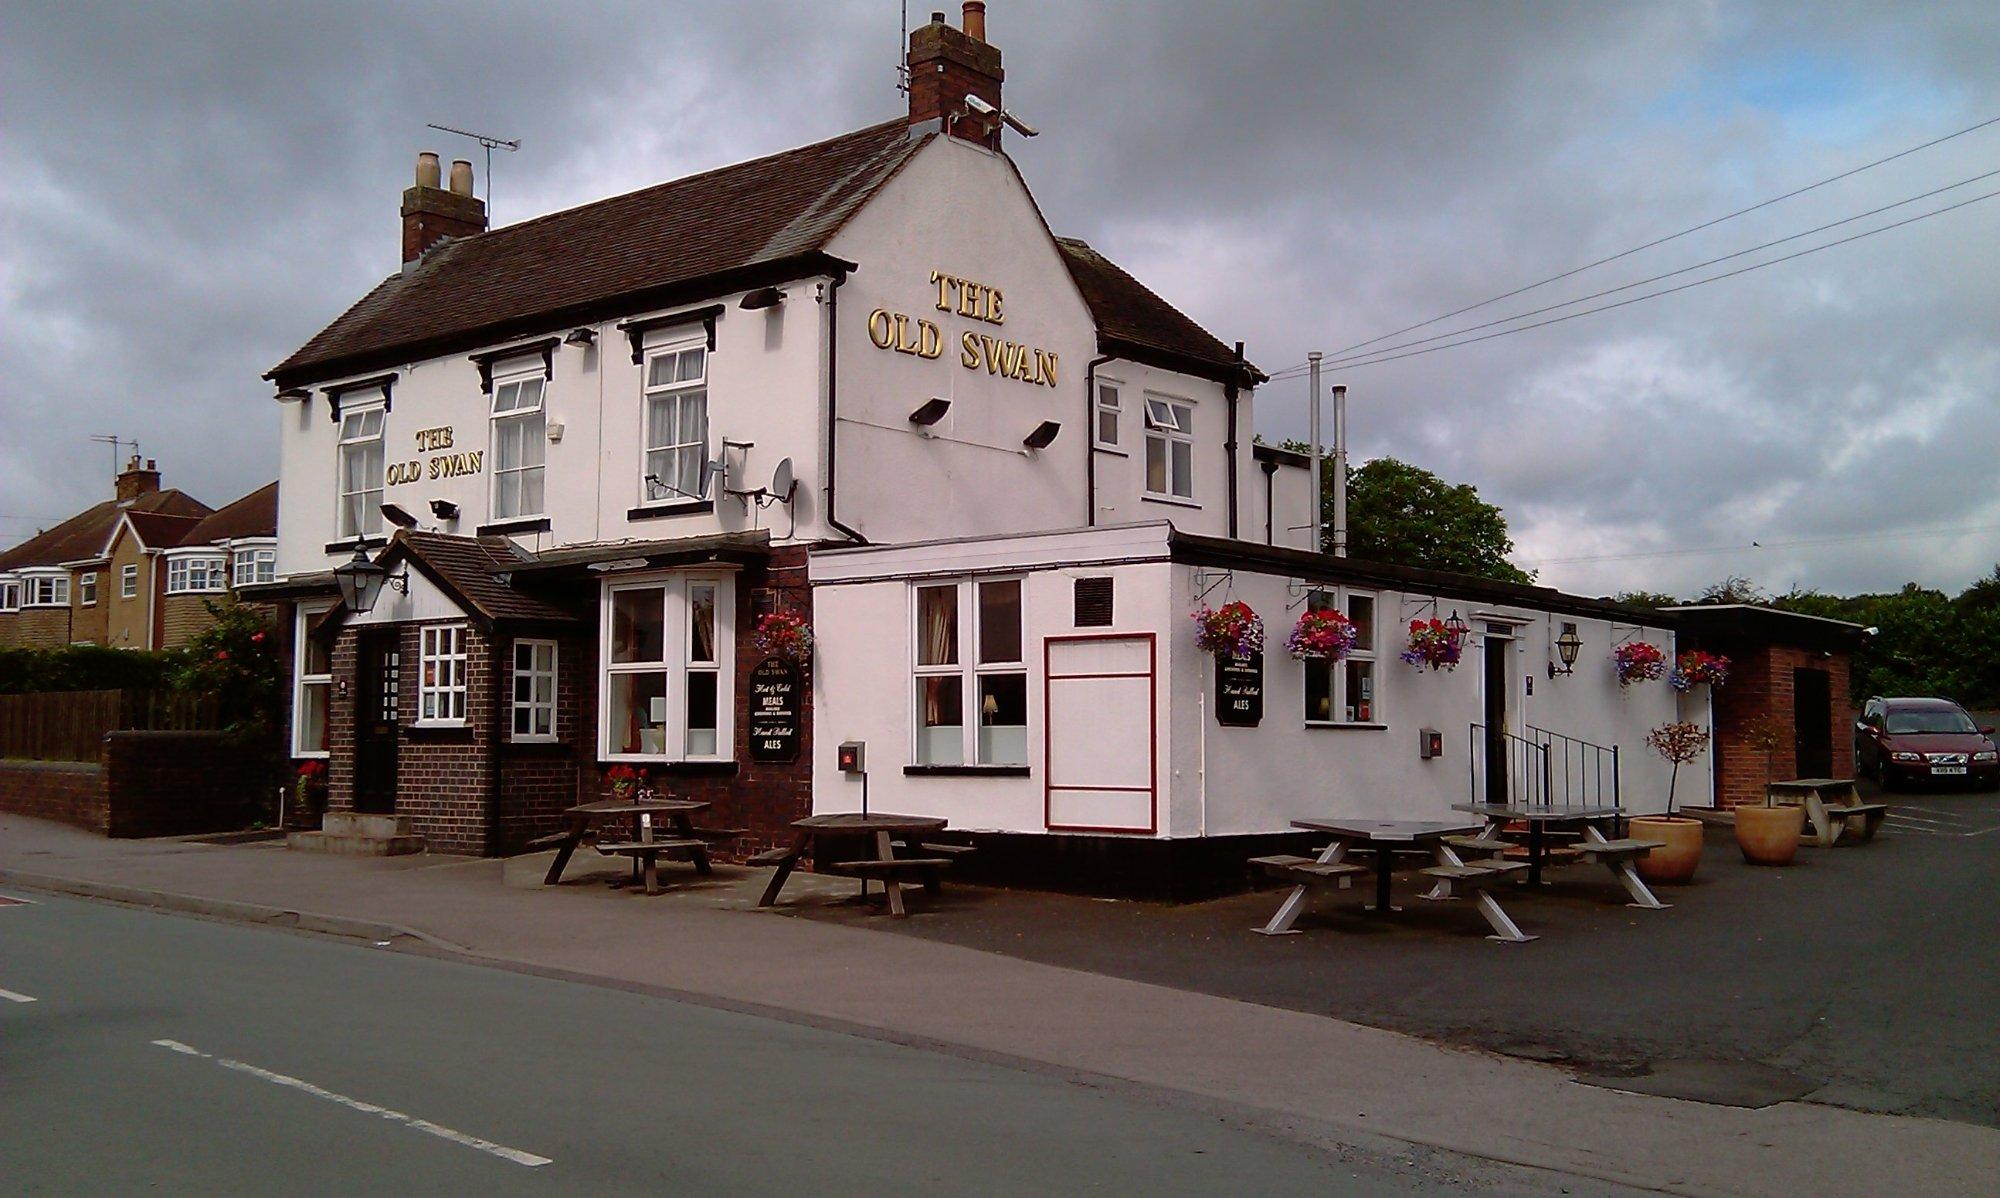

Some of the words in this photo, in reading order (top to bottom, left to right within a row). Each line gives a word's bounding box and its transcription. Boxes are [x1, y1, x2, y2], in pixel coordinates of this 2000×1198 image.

[930, 270, 1006, 326] THE
[868, 308, 944, 360] OLD
[961, 331, 1059, 387] SWAN
[415, 426, 454, 452] THE
[387, 461, 421, 486] OLD
[429, 450, 483, 480] SWAN
[763, 696, 784, 706] MEALS
[1233, 700, 1249, 710] ALES
[764, 740, 781, 749] ALES
